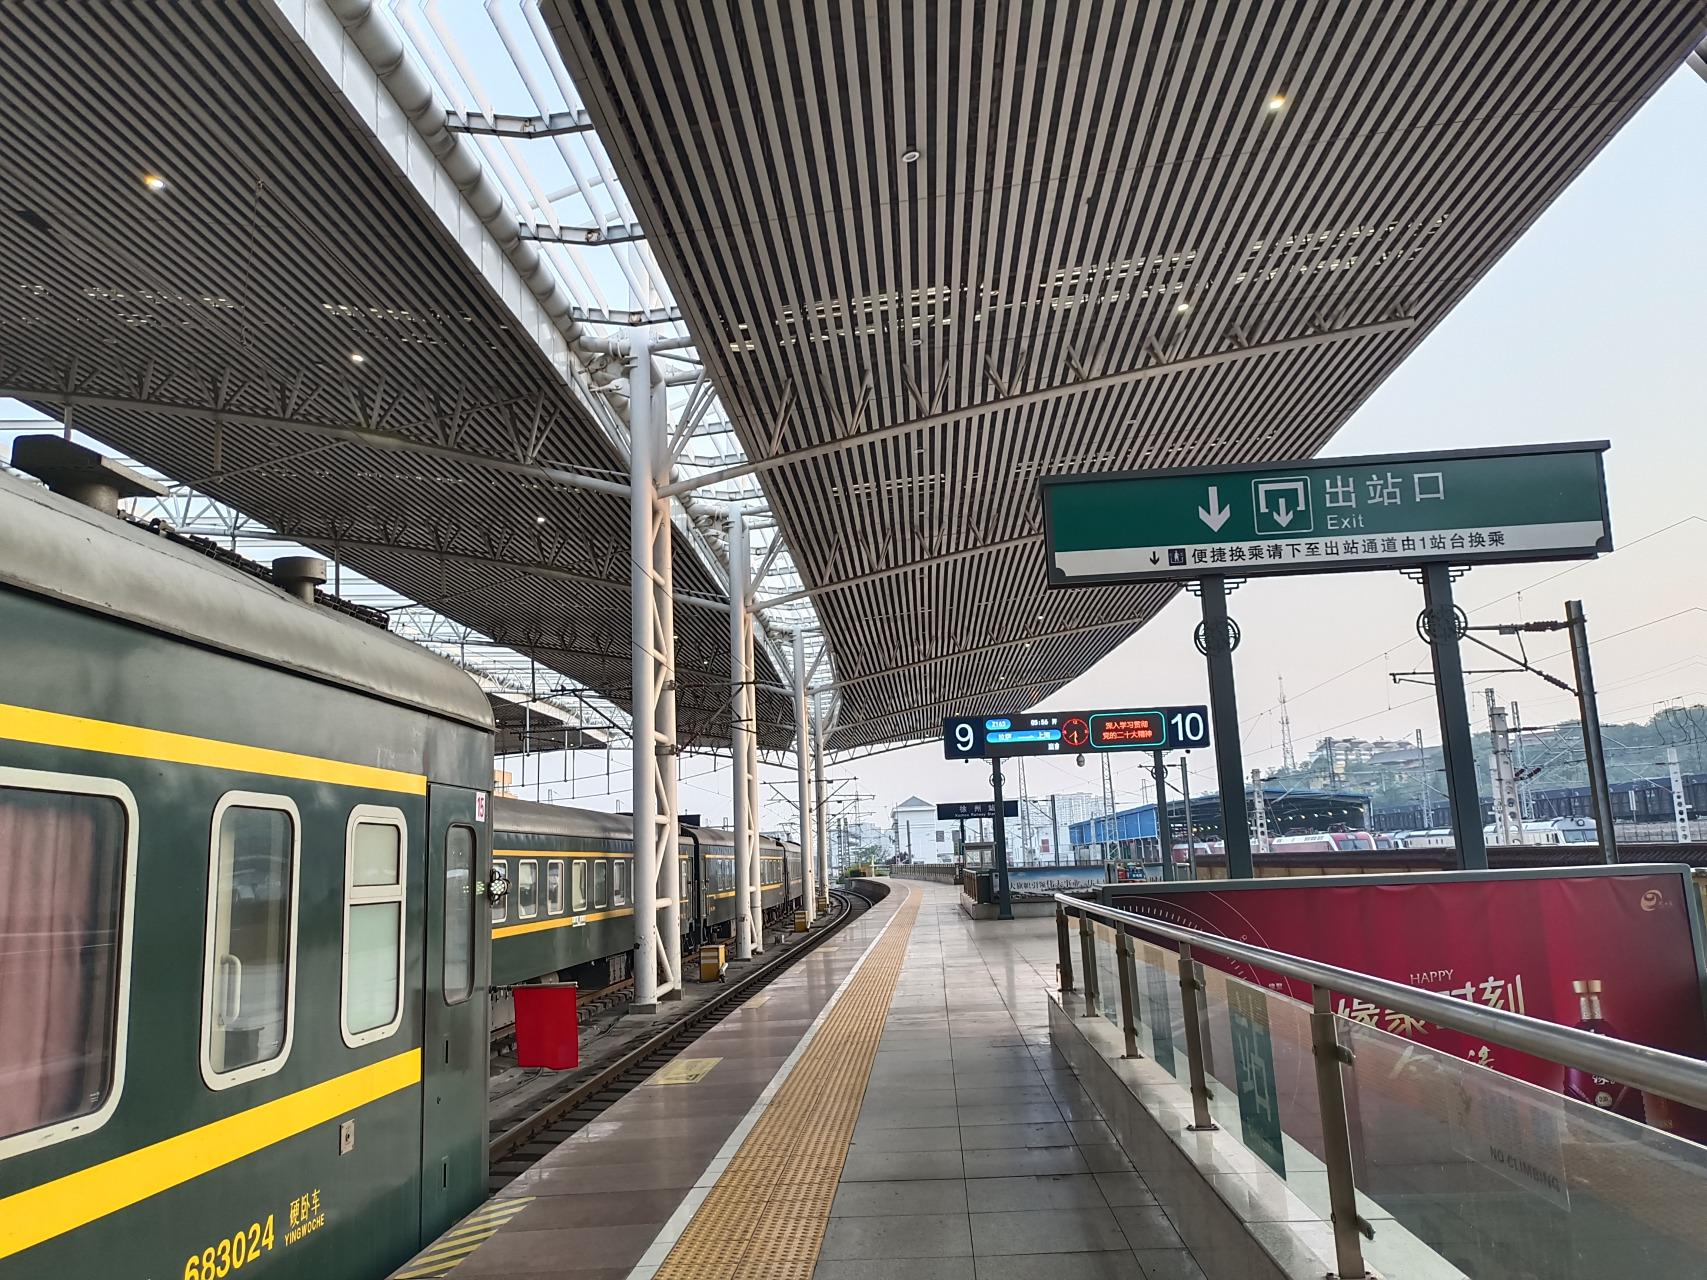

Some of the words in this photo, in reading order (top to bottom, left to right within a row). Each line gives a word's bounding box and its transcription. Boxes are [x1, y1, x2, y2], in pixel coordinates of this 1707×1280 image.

[1325, 472, 1446, 509] 出站口
[1327, 513, 1365, 531] Exit
[1191, 530, 1506, 564] 便捷换乘请下至出站通道由1站台换乘
[955, 723, 975, 751] 9
[1102, 729, 1153, 740] 党的二十大精神
[1170, 712, 1204, 742] 10
[477, 796, 485, 818] 15
[1410, 969, 1454, 985] HAPPY
[1489, 1145, 1505, 1164] NO
[1507, 1155, 1561, 1193] CLIMBING
[289, 1188, 321, 1229] 硬卧车
[284, 1213, 325, 1247] YINGWOCHE
[183, 1214, 276, 1280] 683024
